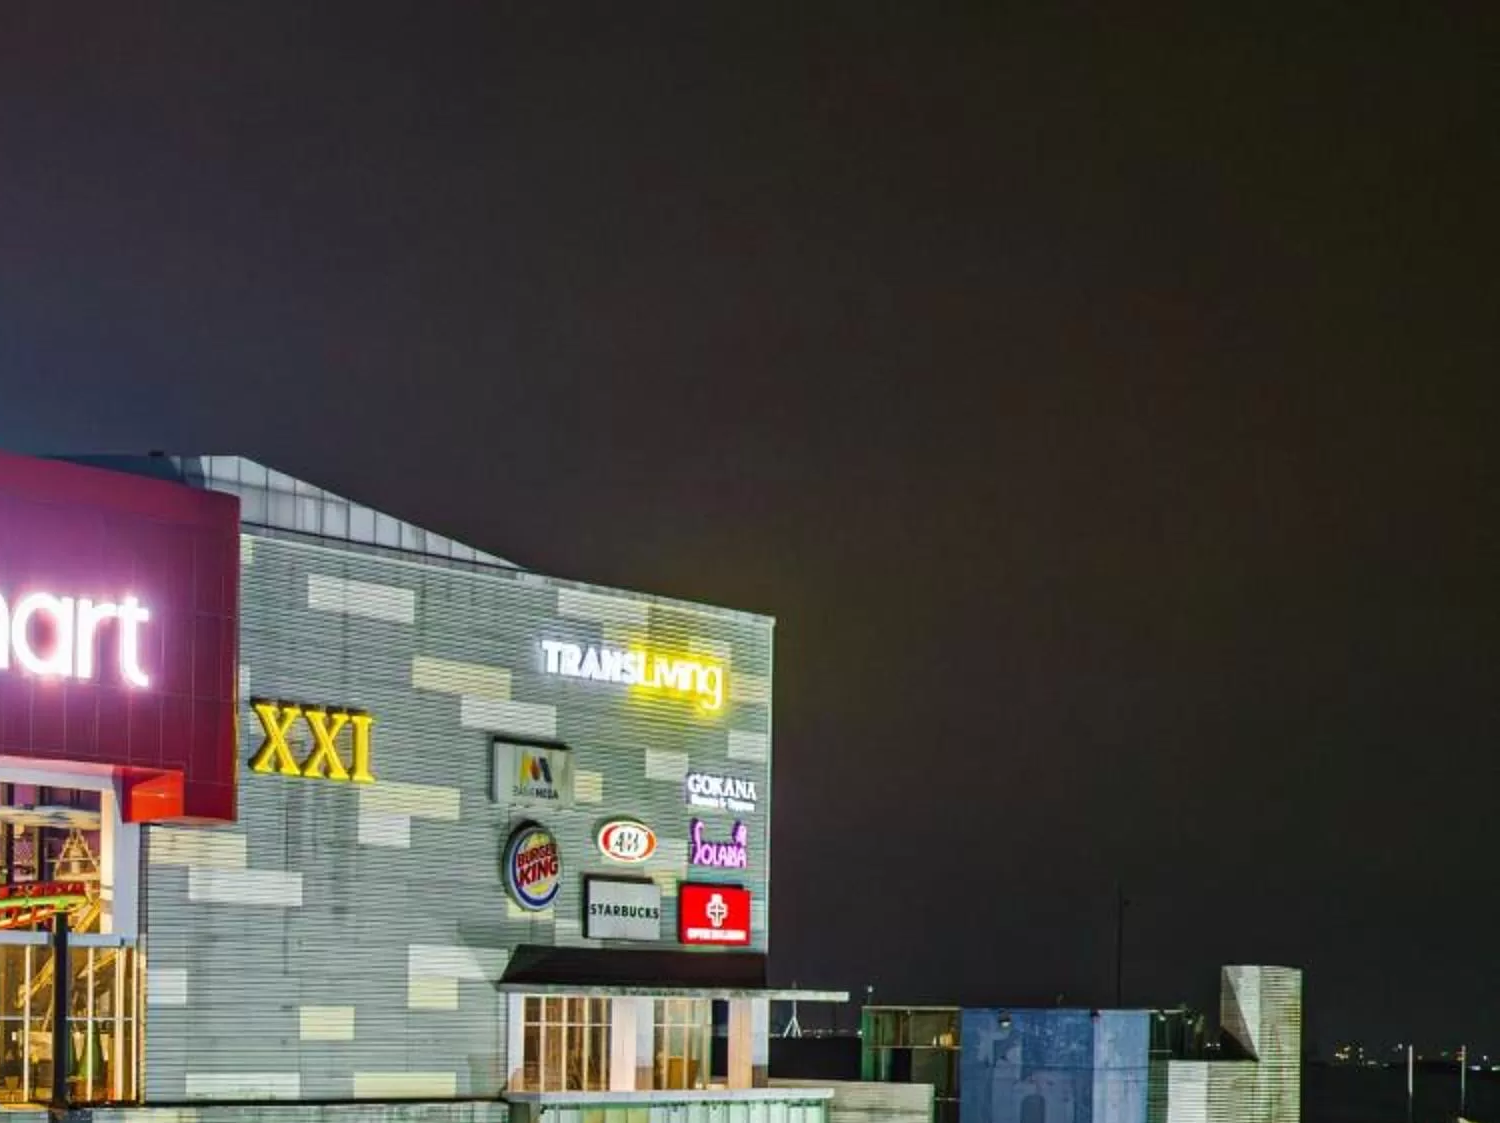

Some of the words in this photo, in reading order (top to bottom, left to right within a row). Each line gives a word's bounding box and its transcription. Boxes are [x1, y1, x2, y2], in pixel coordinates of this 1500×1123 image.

[252, 701, 376, 784] XXI
[687, 773, 757, 801] GOKANA
[516, 842, 558, 869] BURGER
[516, 859, 560, 889] KING
[590, 902, 660, 920] STARBUCKS
